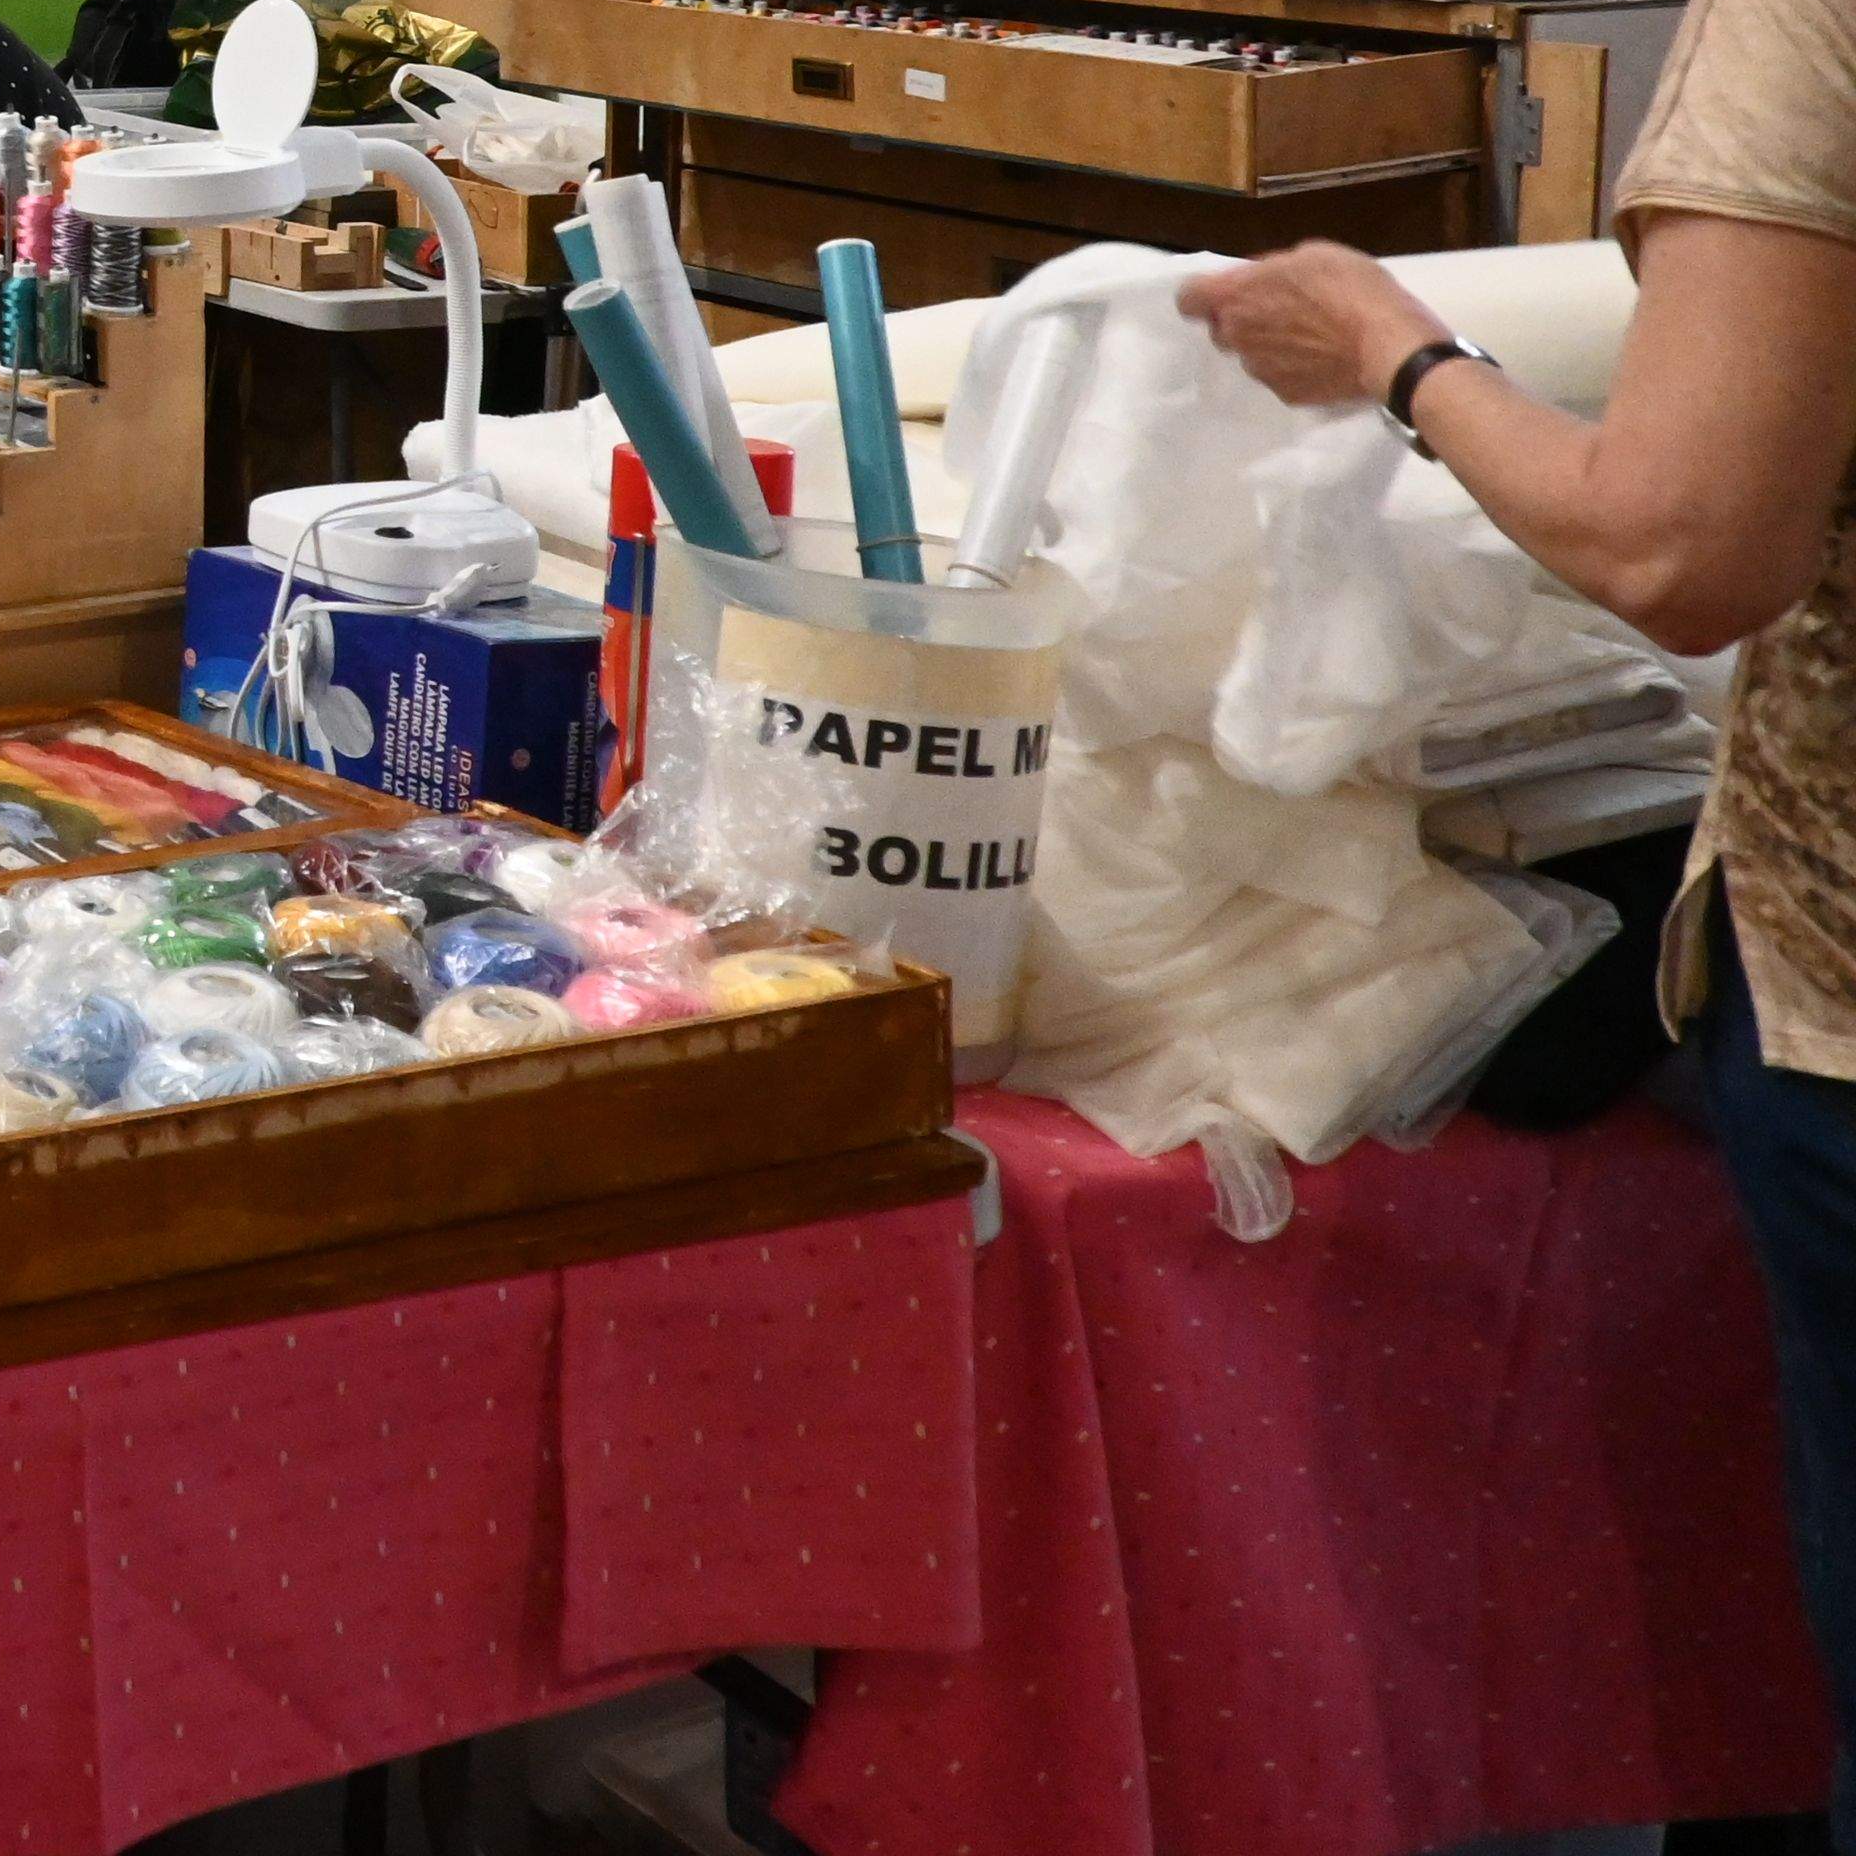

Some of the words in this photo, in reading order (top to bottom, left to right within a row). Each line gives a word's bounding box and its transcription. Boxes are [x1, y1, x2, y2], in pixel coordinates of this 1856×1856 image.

[386, 672, 401, 719] LAMPE
[411, 653, 427, 736] CANDEEIRO
[395, 698, 411, 777] MAGNIFIER
[434, 685, 451, 752] LÁMPARA
[757, 697, 994, 778] PAPEL
[383, 722, 395, 769] LOUPE
[408, 740, 420, 774] COM
[421, 751, 433, 779] LED
[394, 780, 405, 796] LA
[434, 757, 446, 784] LED
[457, 750, 473, 813] IDEAS
[431, 788, 443, 815] CO
[812, 825, 1038, 891] BOLILL
